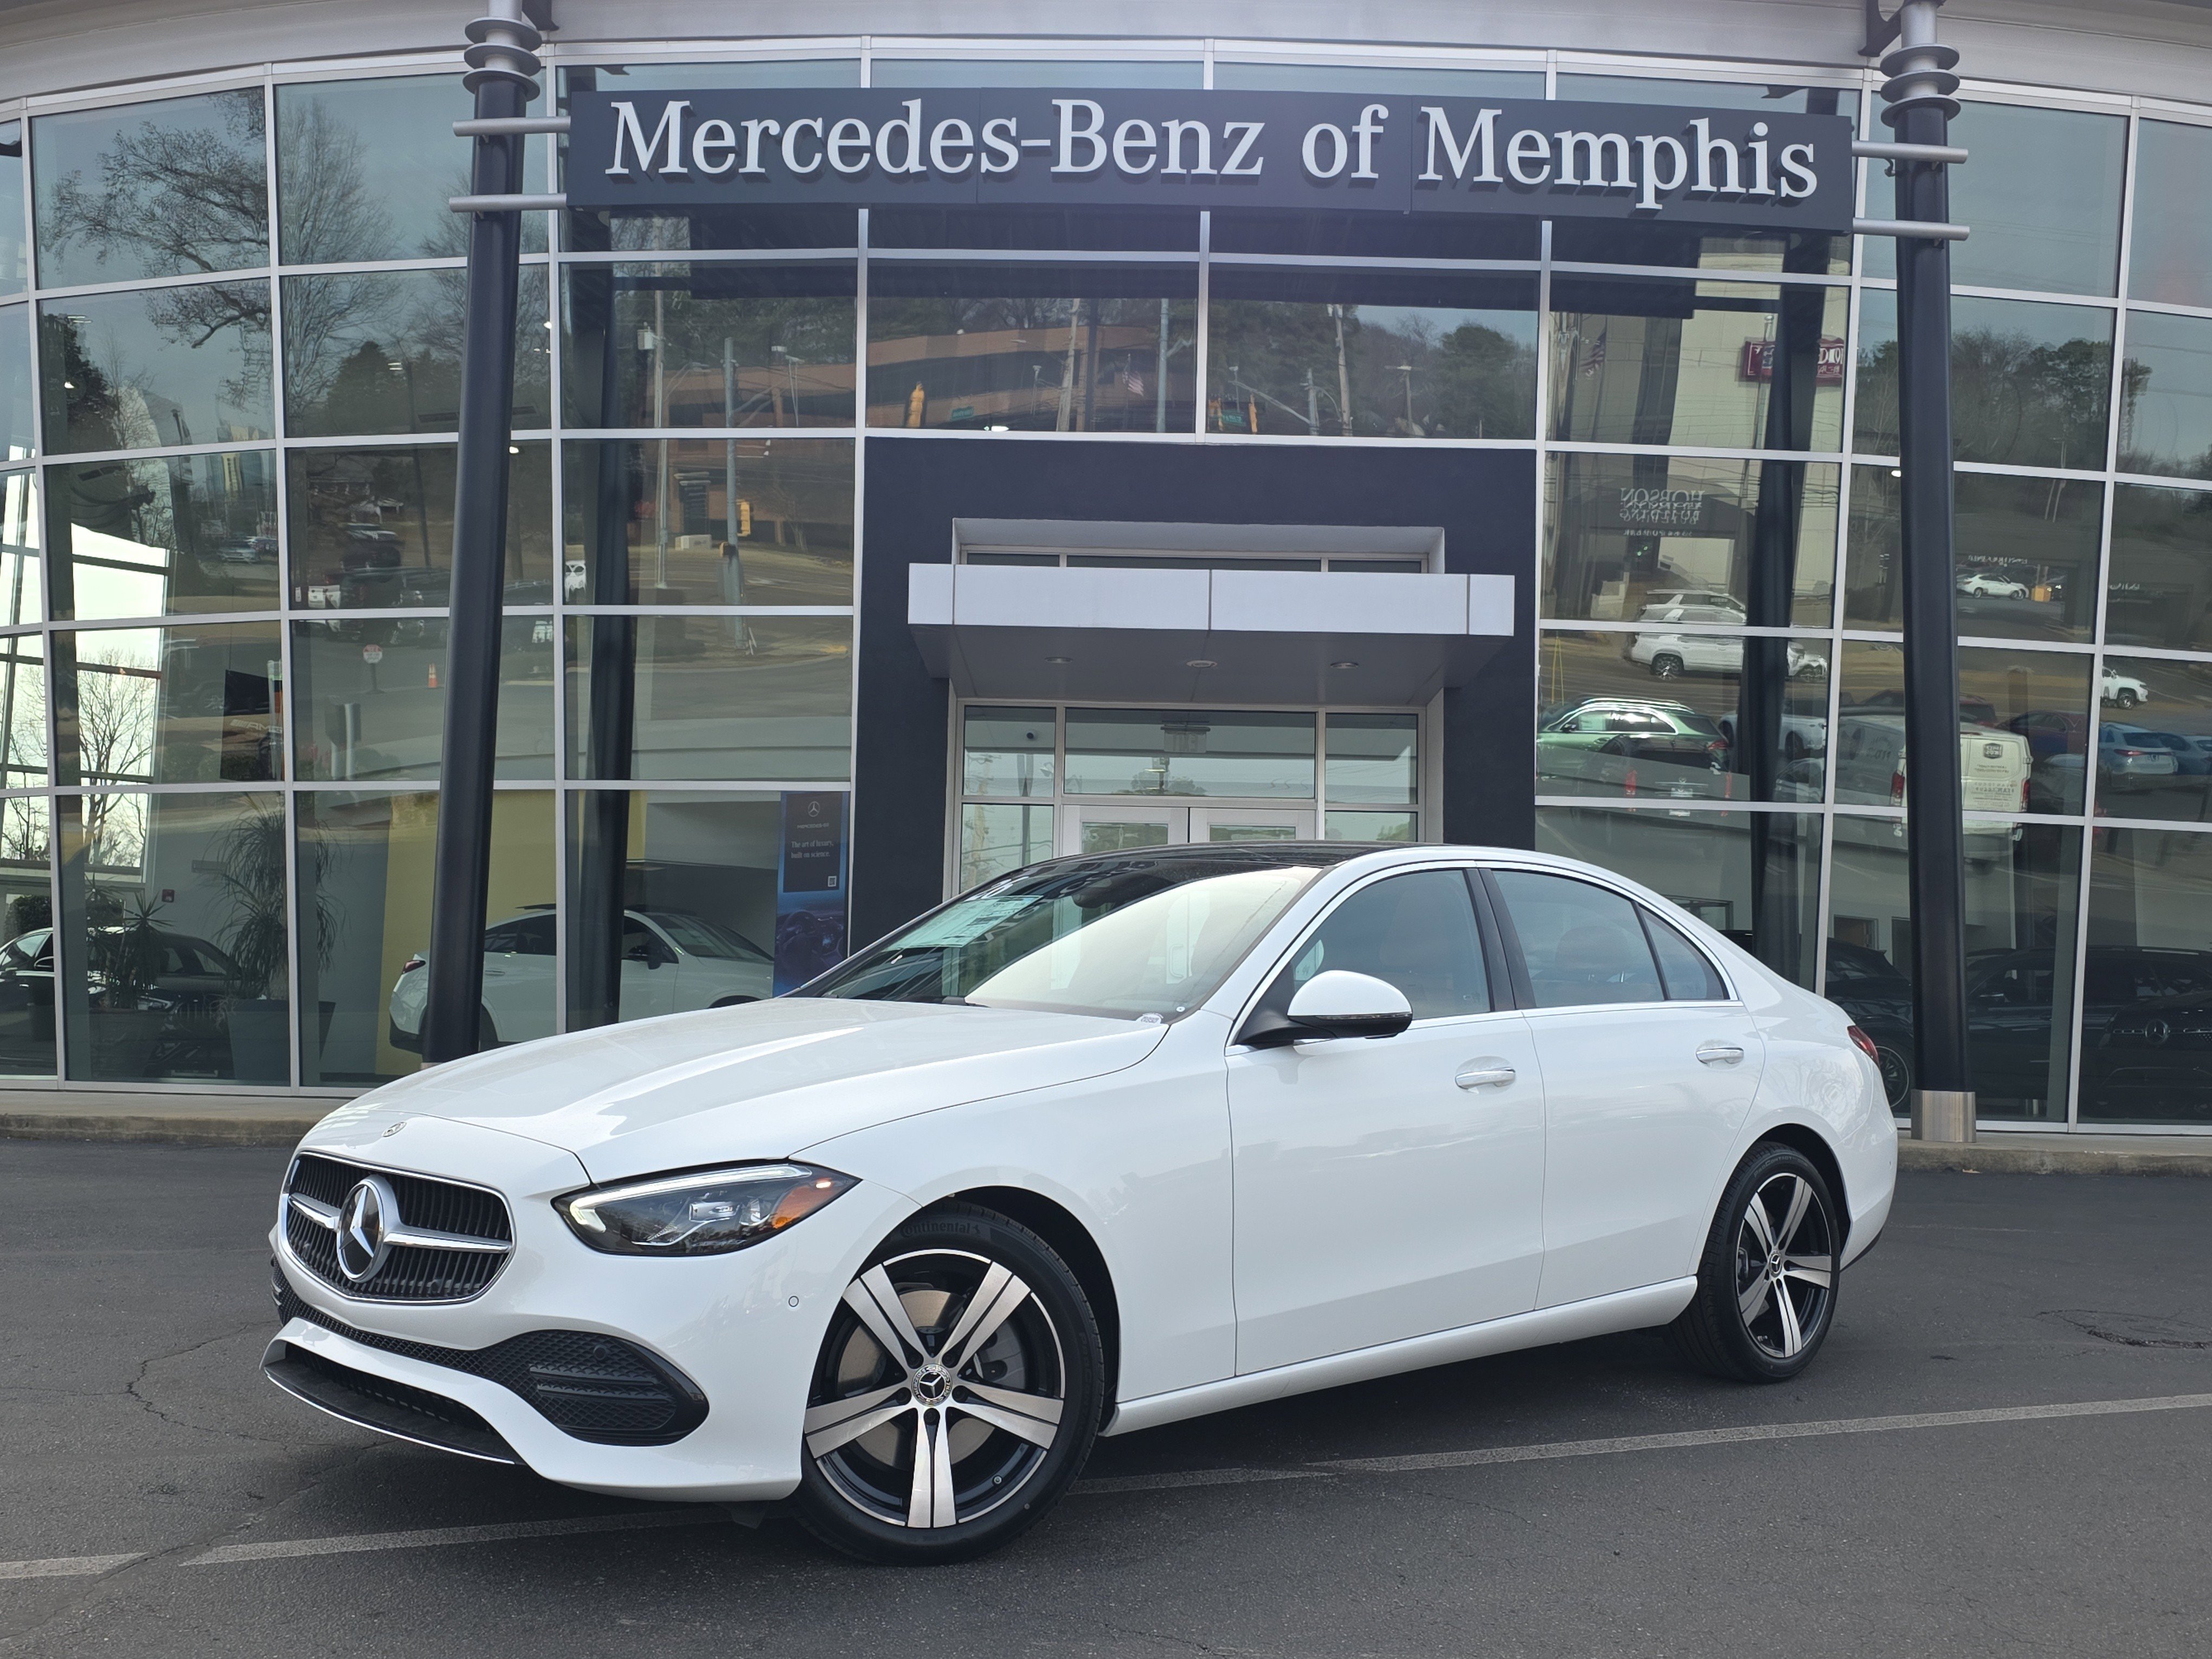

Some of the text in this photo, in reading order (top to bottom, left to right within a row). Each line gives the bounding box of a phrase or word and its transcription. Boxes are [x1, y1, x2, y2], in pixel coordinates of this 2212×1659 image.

[605, 98, 1818, 210] Mercedes-Benz of Memphis
[899, 1221, 970, 1238] Continental
